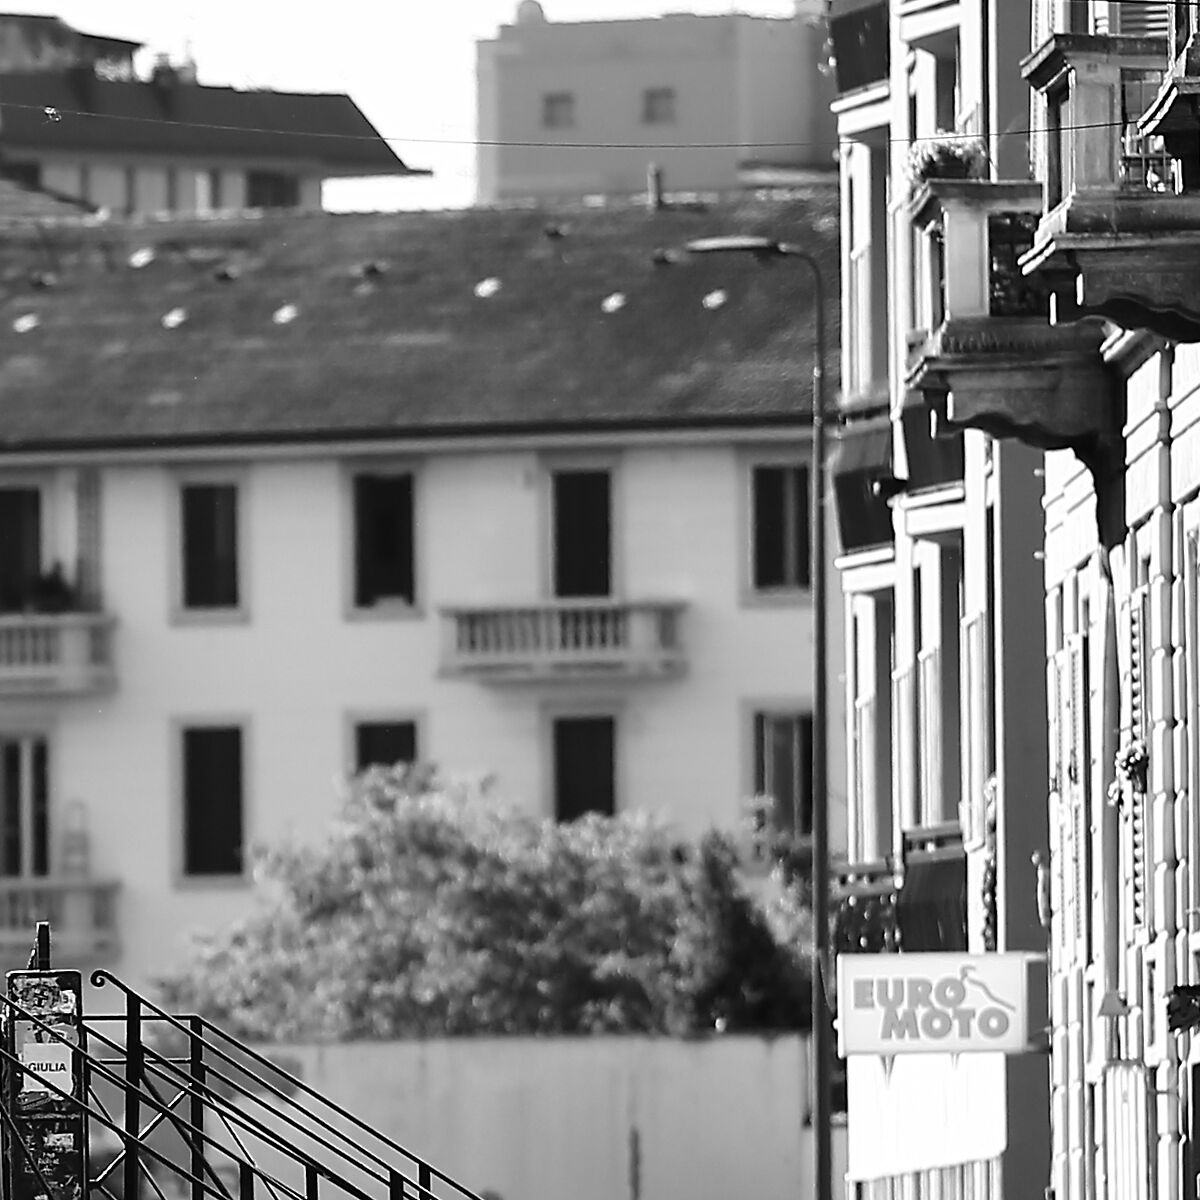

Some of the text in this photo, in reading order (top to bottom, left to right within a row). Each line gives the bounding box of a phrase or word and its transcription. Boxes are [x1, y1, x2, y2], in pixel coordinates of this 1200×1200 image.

[854, 977, 967, 1009] EURO
[882, 1007, 1009, 1040] MOTO
[29, 1061, 67, 1073] GIULIA
